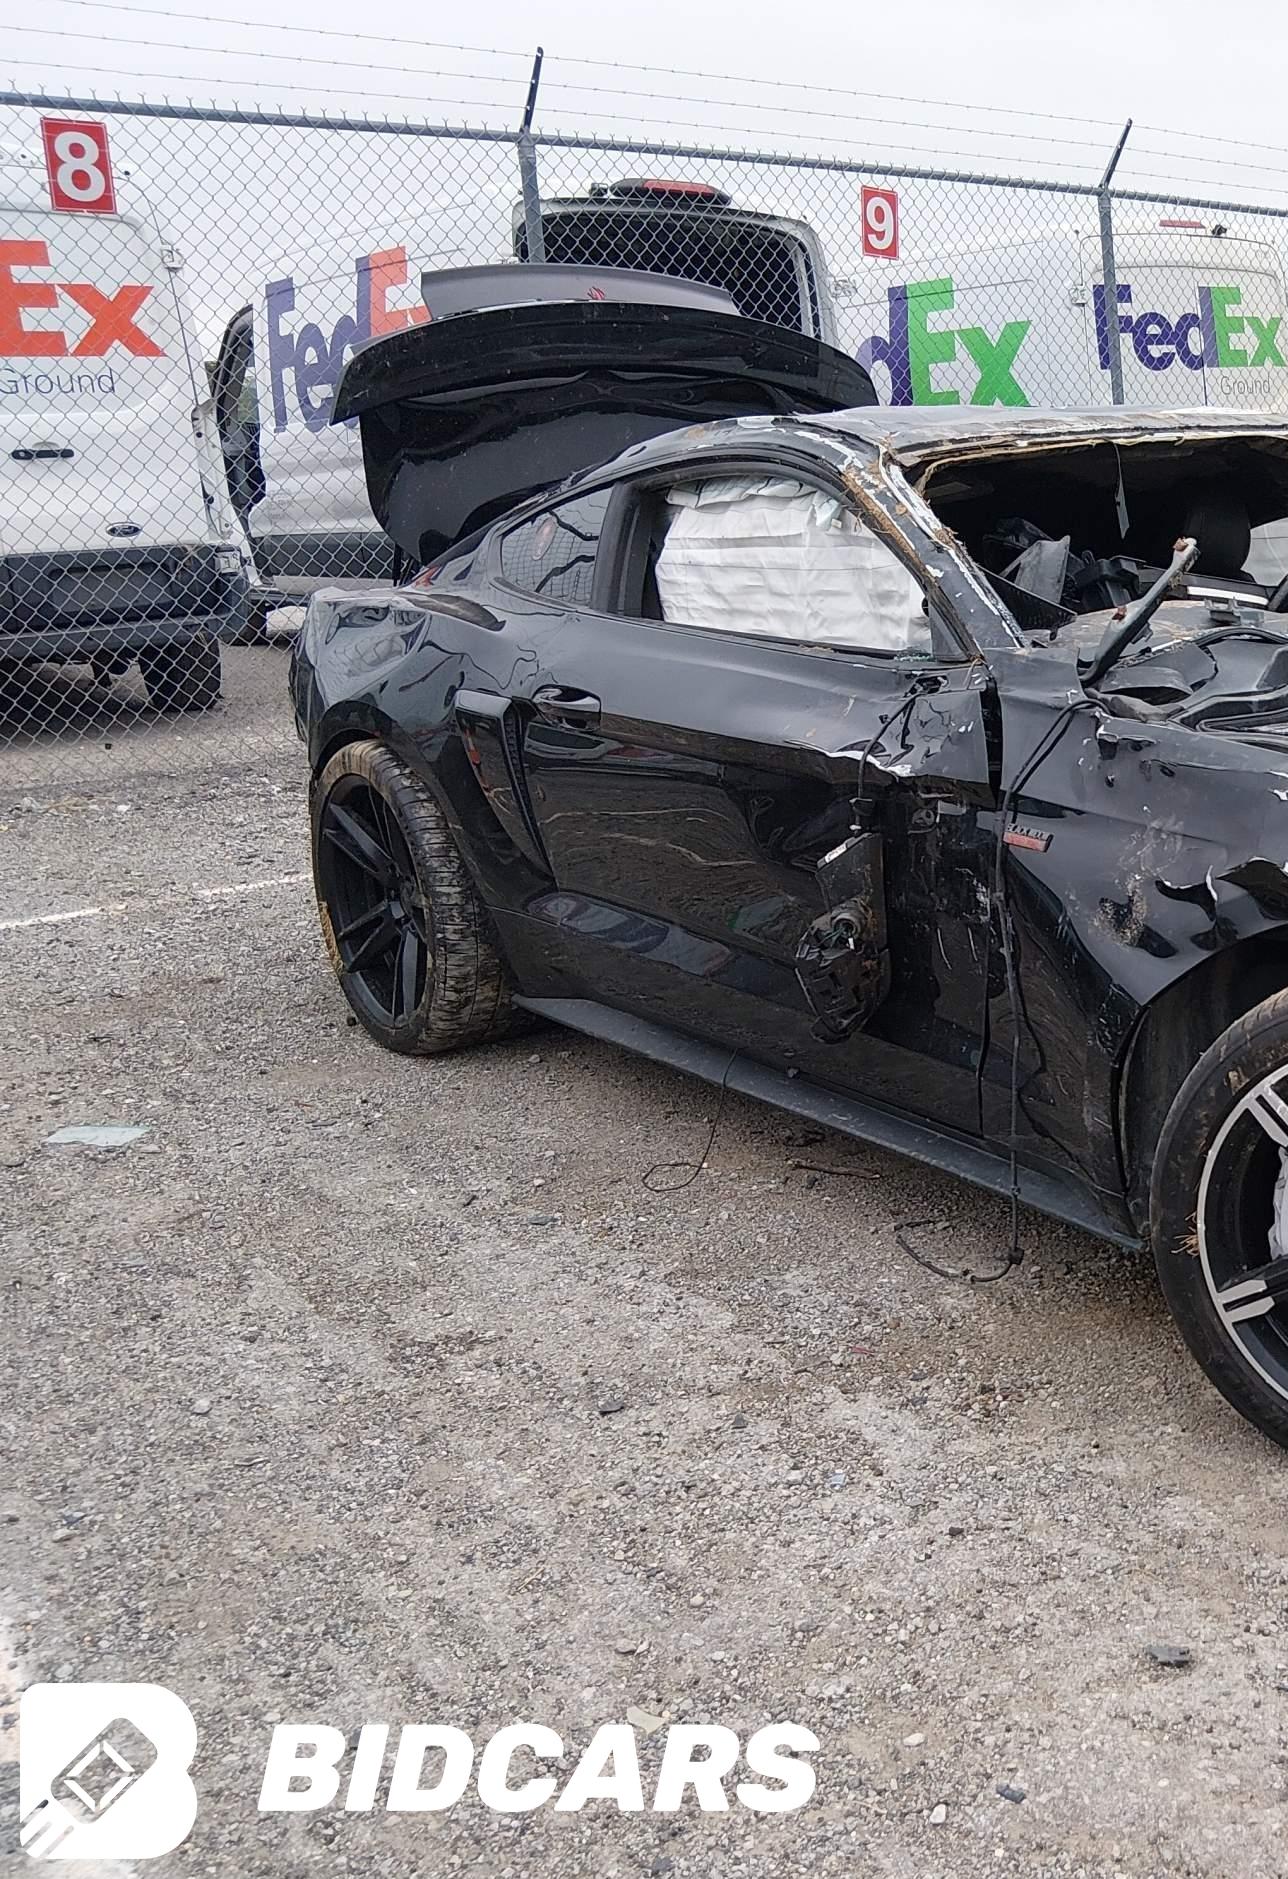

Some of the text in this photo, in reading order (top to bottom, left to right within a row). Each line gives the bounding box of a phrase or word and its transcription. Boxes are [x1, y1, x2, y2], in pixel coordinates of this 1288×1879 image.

[54, 131, 106, 201] 8
[866, 196, 894, 250] 9
[265, 246, 432, 433] FedE
[1093, 284, 1288, 371] FedEx
[0, 367, 116, 395] Ground
[1220, 375, 1271, 396] Ground
